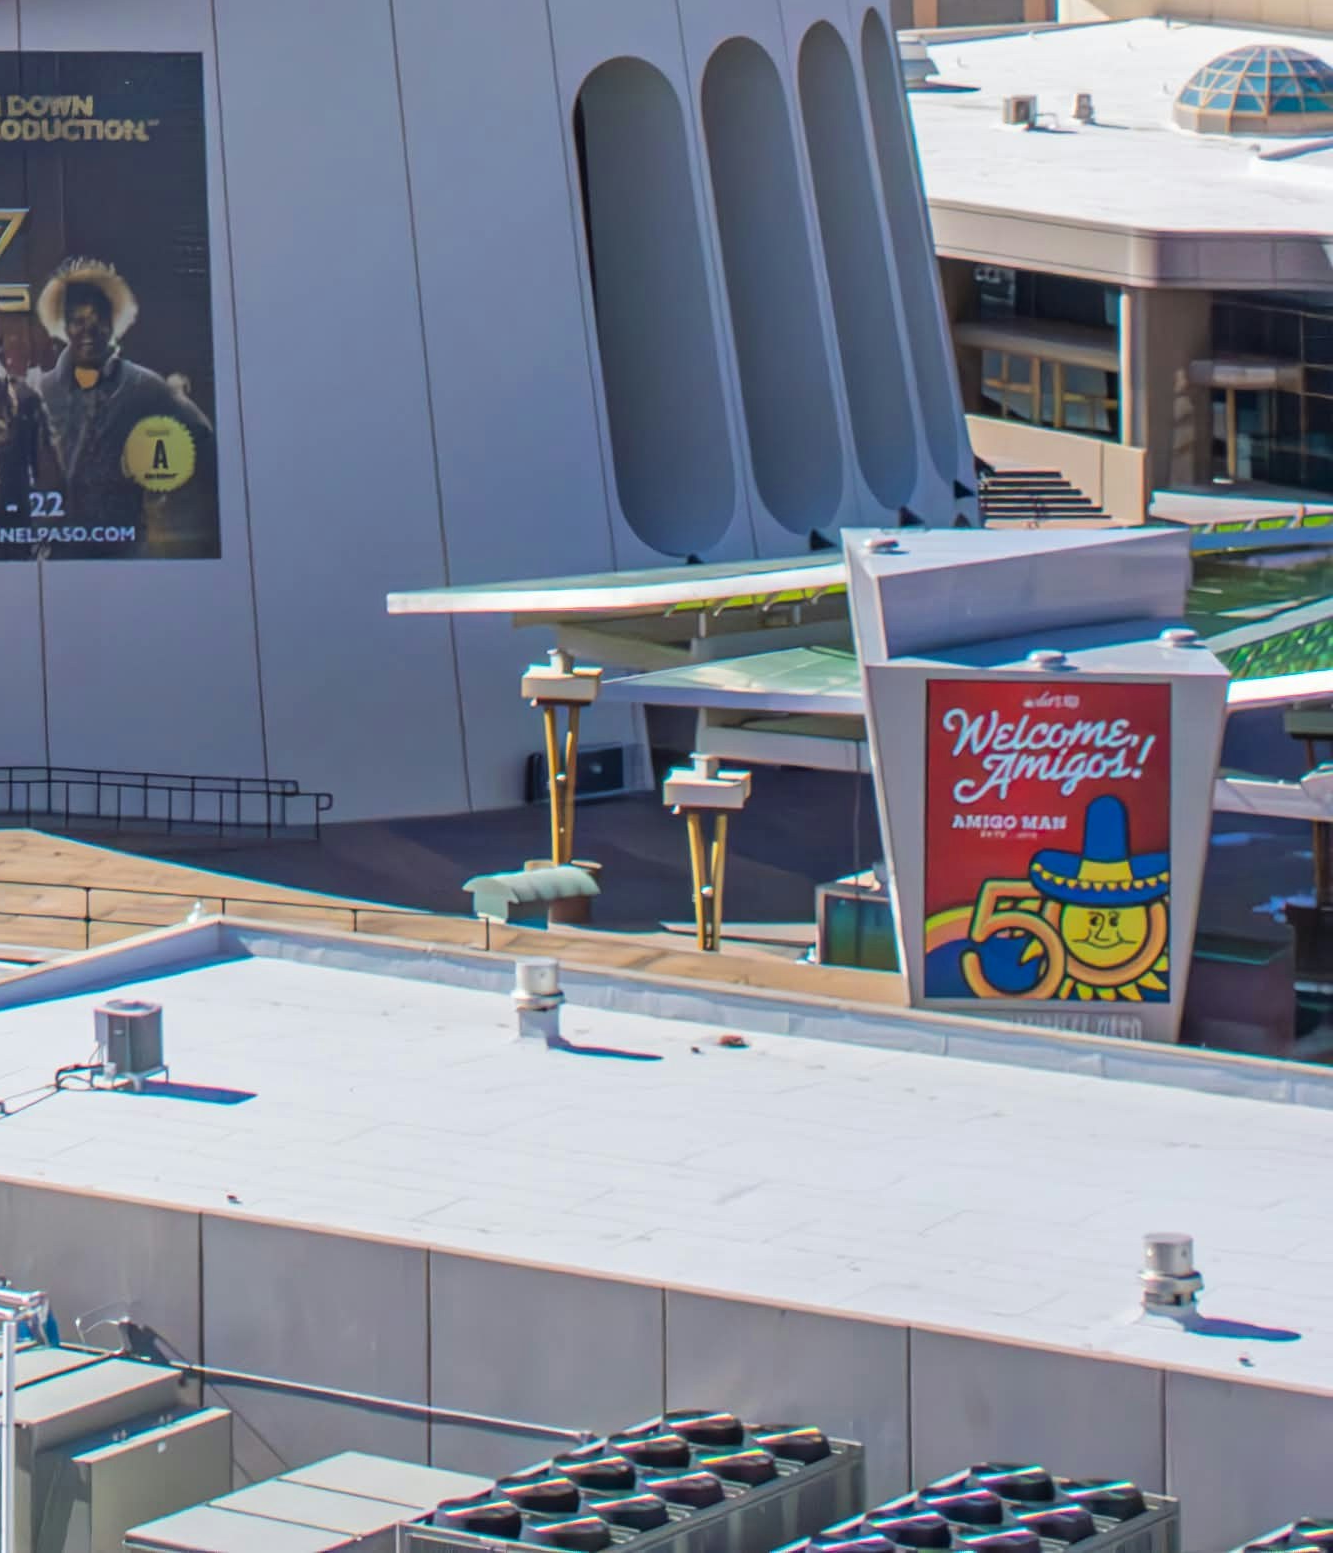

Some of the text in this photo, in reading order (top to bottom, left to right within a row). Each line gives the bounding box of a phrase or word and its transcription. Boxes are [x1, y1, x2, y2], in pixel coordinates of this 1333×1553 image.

[8, 96, 93, 118] DOWN
[153, 439, 169, 470] A
[29, 492, 66, 517] 22
[942, 707, 1140, 757] Welcome,
[952, 734, 1156, 804] Amigos!
[952, 814, 1067, 831] AMIGO MAN
